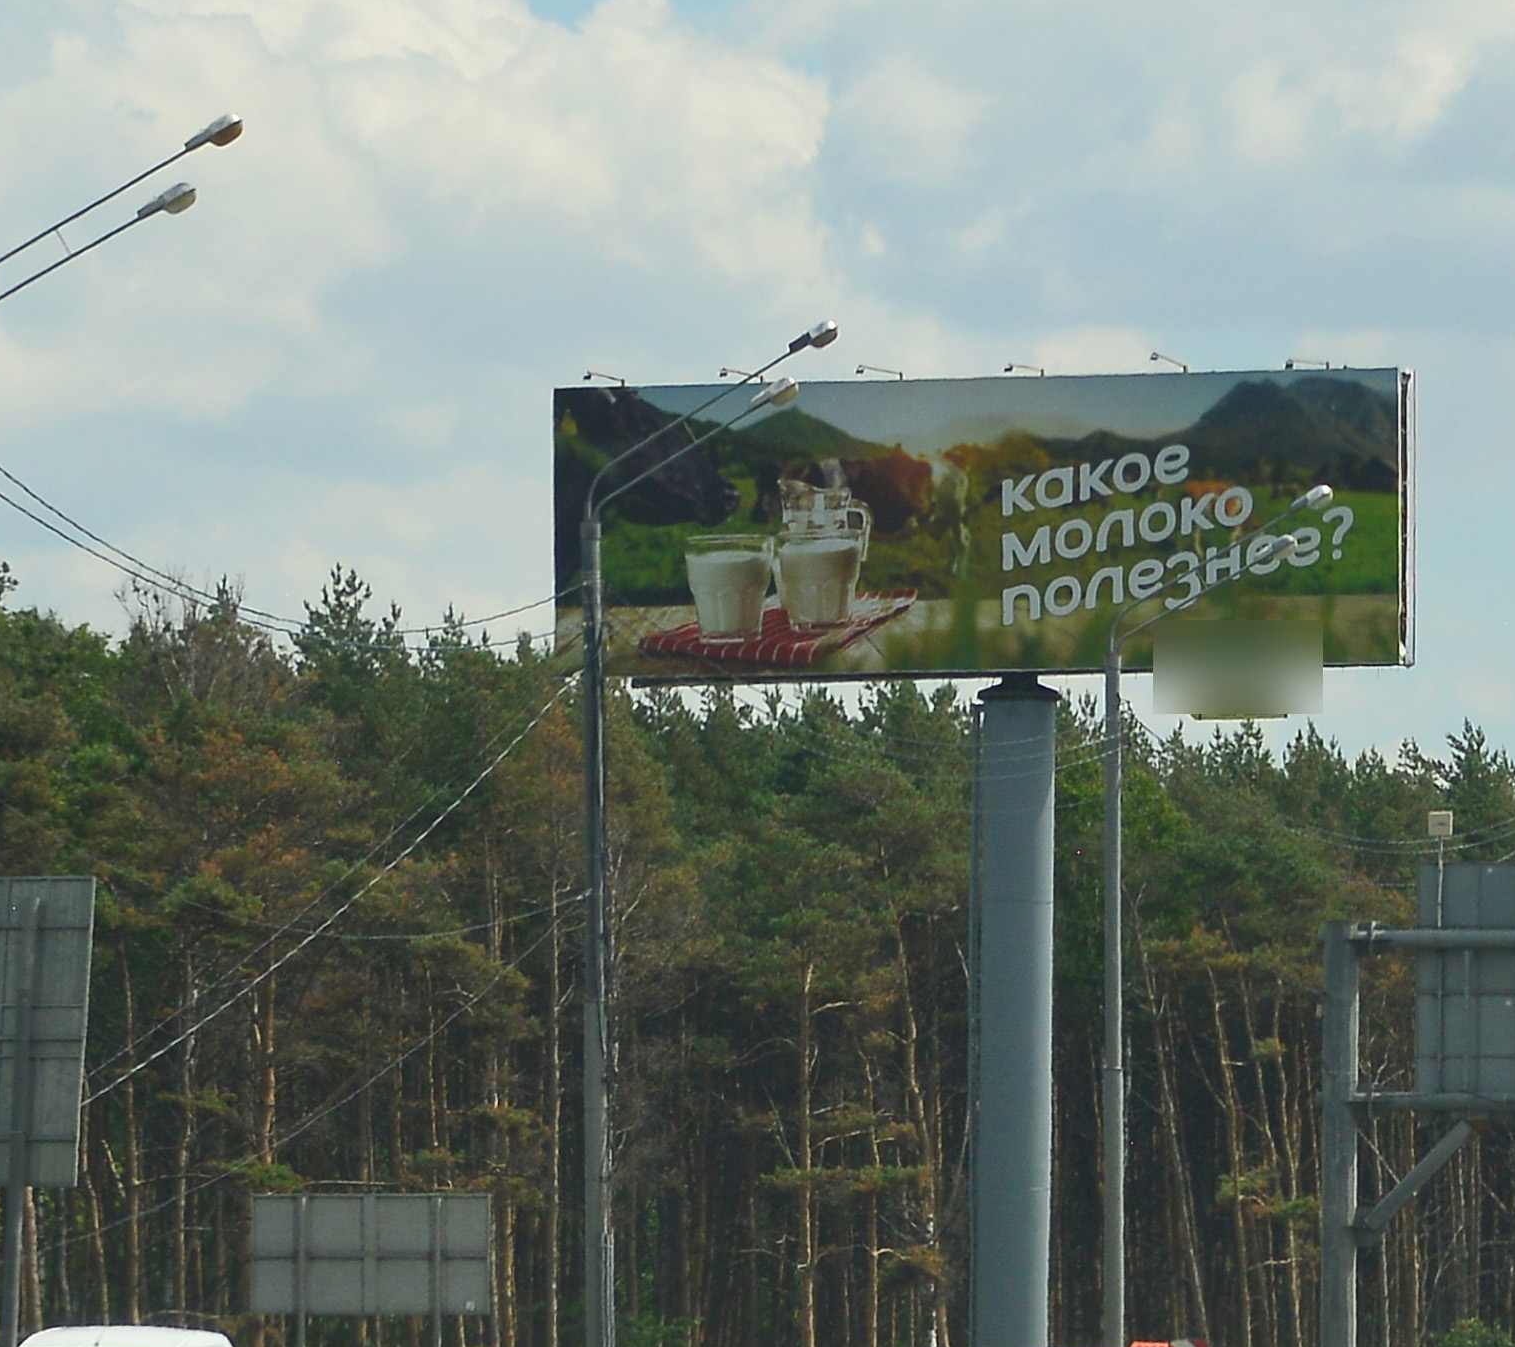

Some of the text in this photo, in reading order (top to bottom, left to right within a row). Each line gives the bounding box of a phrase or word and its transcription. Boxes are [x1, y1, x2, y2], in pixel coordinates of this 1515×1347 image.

[1000, 444, 1190, 516] какое
[1000, 486, 1254, 571] молоко
[1000, 506, 1354, 626] полезнее?
